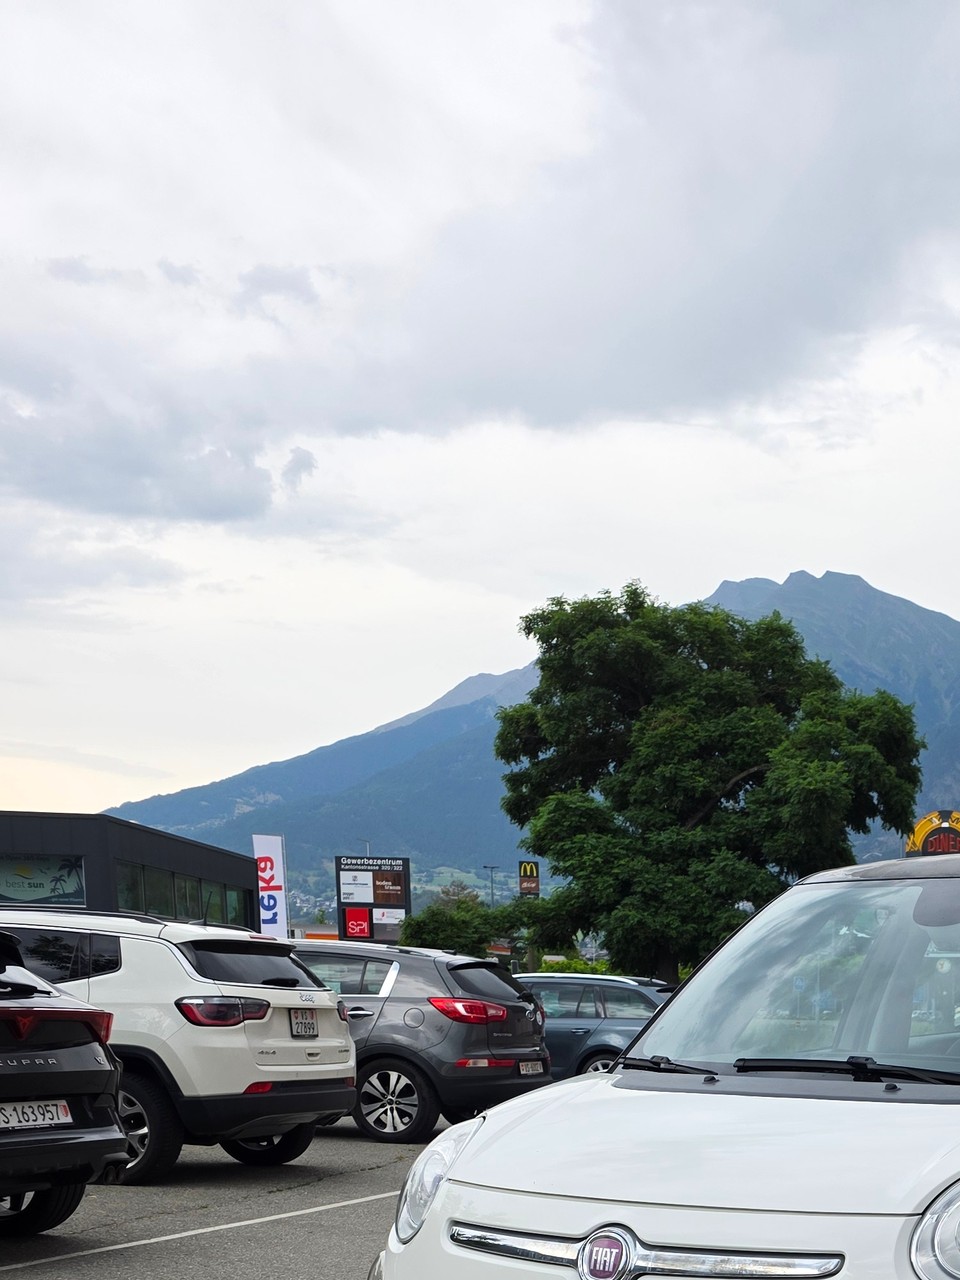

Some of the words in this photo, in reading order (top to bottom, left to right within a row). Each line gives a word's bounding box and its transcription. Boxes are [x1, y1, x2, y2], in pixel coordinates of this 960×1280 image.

[340, 857, 403, 865] Gewerbezentrum
[5, 879, 26, 889] best
[27, 881, 45, 889] sun
[256, 856, 283, 925] reka
[348, 921, 368, 933] SPI
[301, 1011, 308, 1020] VS
[295, 1022, 315, 1034] 27899
[590, 1246, 620, 1272] FIAT
